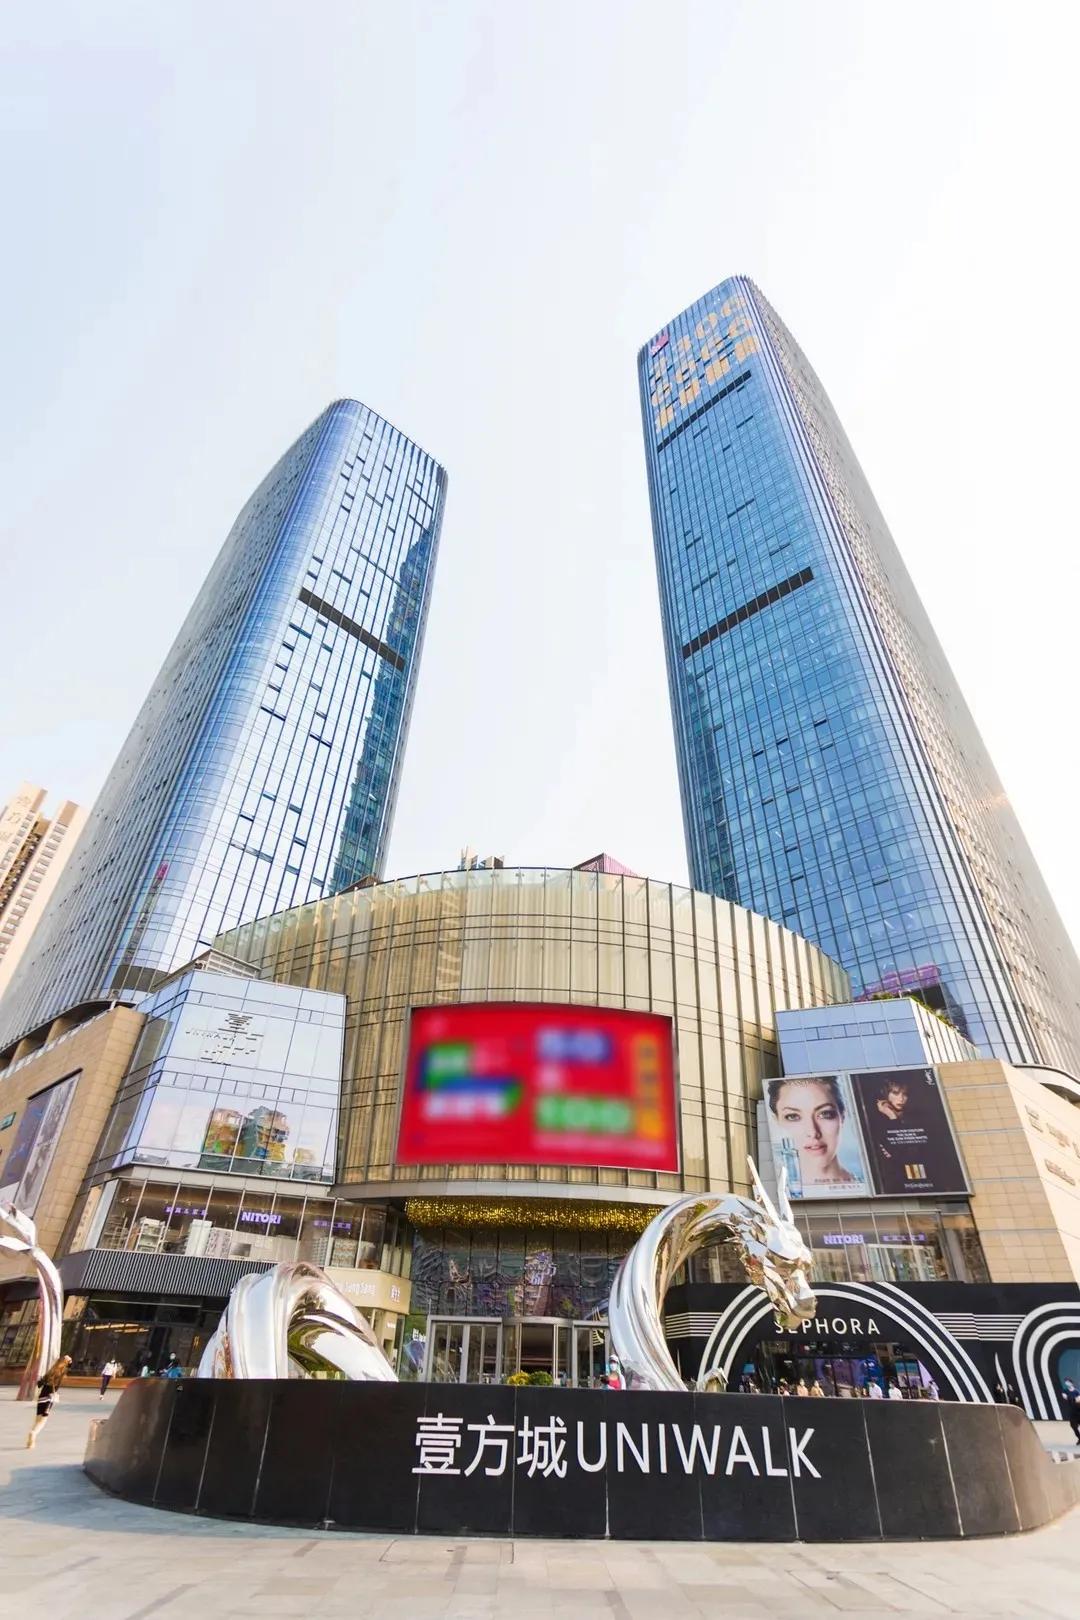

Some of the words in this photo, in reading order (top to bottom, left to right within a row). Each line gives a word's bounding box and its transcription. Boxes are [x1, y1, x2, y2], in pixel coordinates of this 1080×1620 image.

[241, 1211, 282, 1225] NITORI
[823, 1233, 864, 1245] NITORI
[774, 1318, 881, 1335] SPHORA
[411, 1412, 568, 1479] 壹方城
[576, 1420, 822, 1479] UNIWALK
